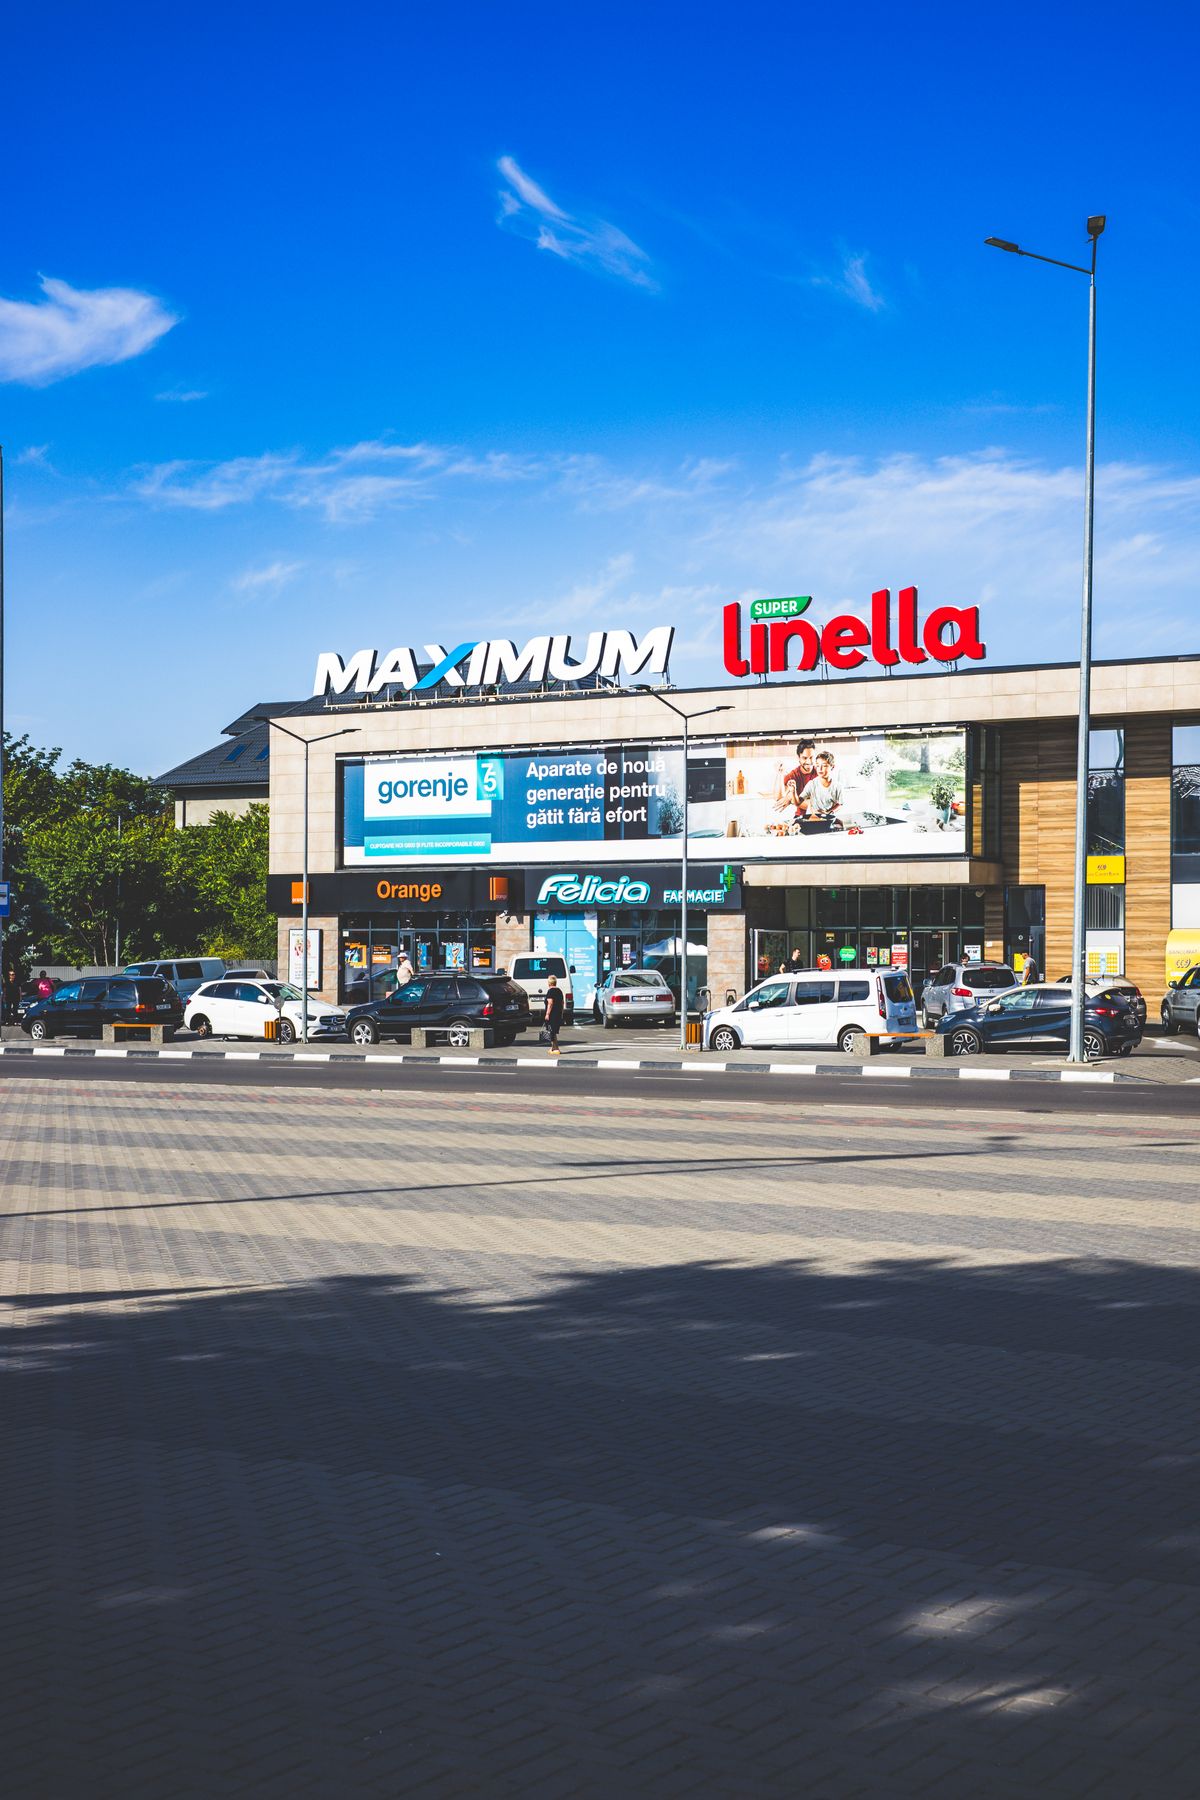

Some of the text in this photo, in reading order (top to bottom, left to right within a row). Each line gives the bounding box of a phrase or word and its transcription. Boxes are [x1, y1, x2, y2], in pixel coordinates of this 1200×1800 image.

[754, 599, 798, 615] SUPER
[723, 585, 986, 677] linella
[313, 626, 674, 696] MAXIMUM
[526, 755, 666, 781] Aparate de nouă
[378, 772, 468, 804] gorenje
[526, 782, 666, 805] generație pentru
[526, 807, 647, 829] gătit fără efort
[377, 880, 442, 902] Orange
[537, 874, 651, 904] Felicia
